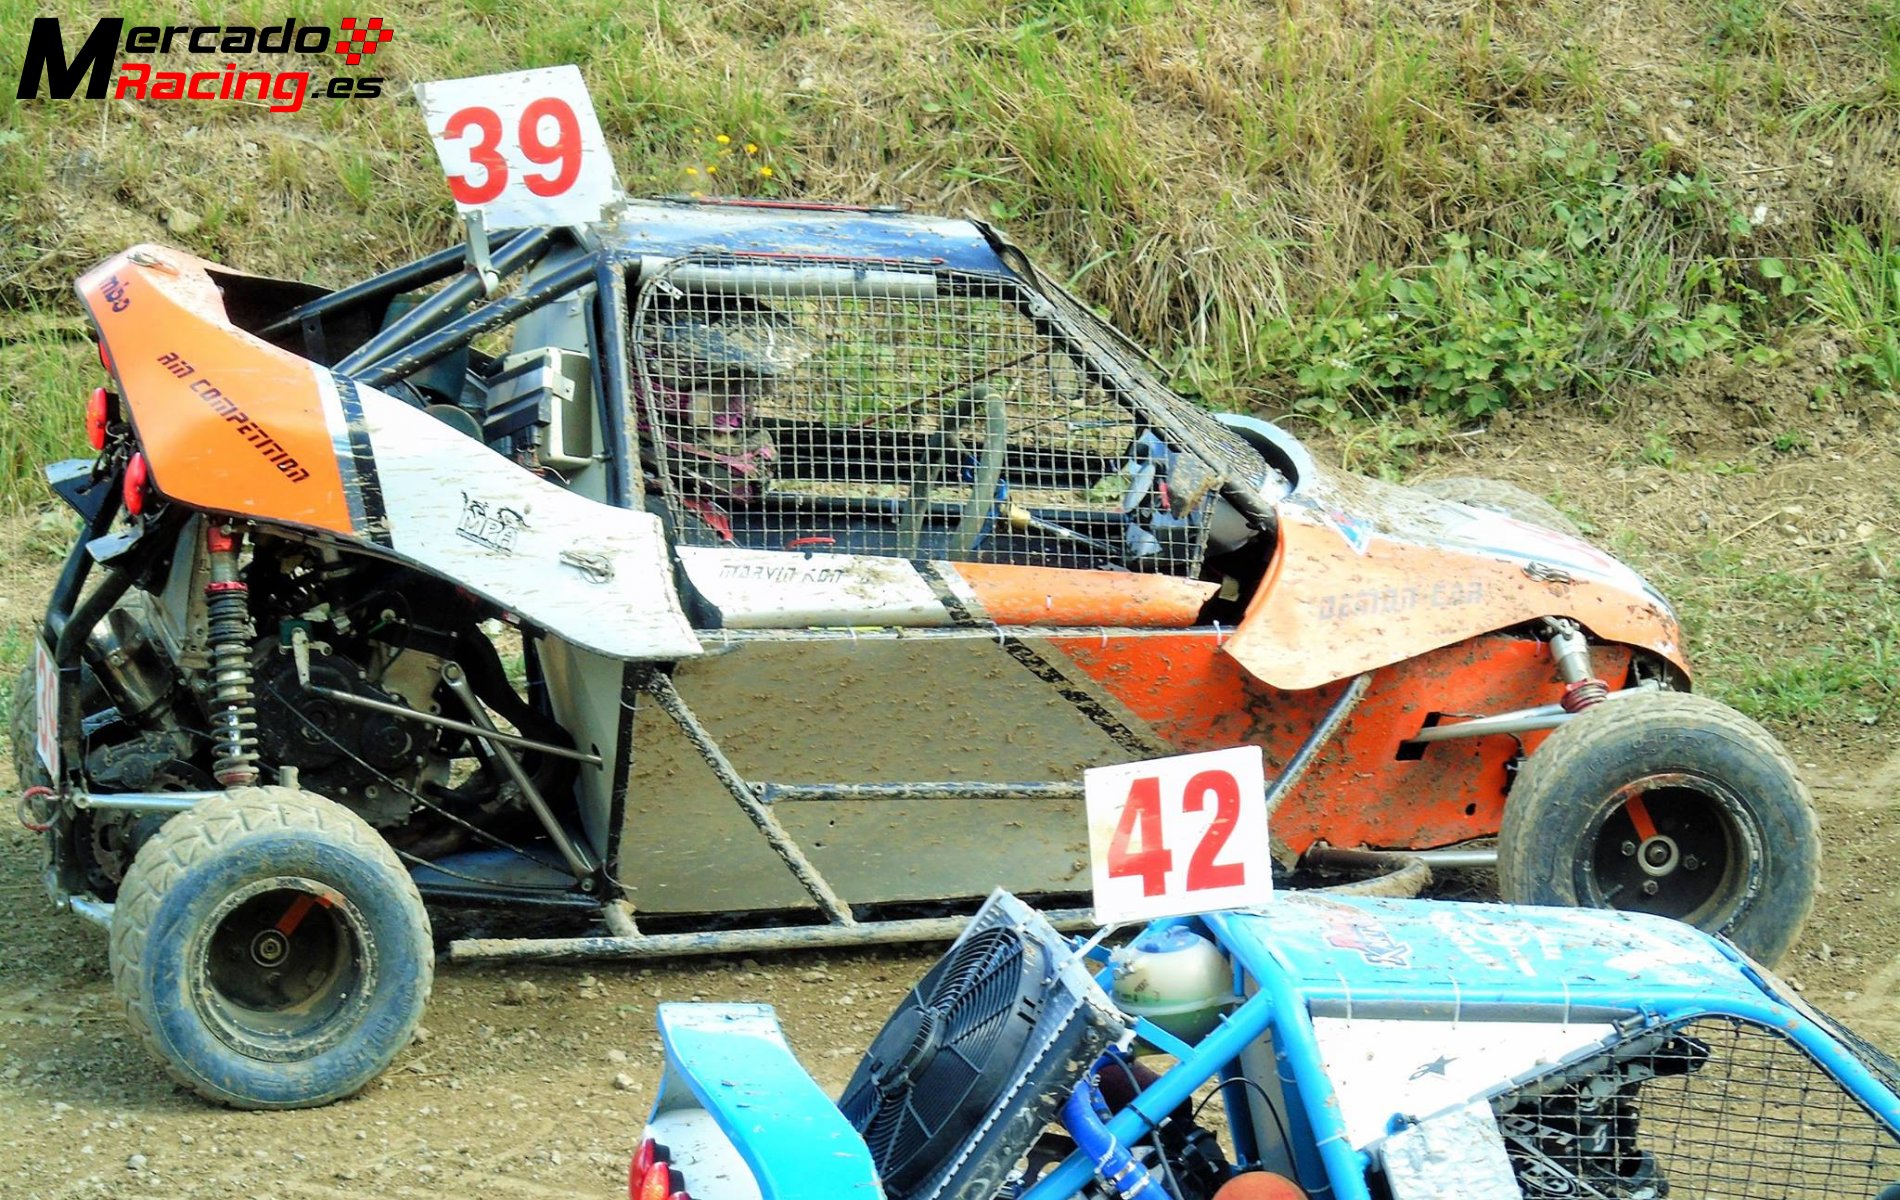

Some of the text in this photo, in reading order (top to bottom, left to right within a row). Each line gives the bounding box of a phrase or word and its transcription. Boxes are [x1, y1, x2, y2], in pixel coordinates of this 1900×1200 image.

[443, 96, 583, 205] 39
[190, 379, 310, 483] COMPETITION
[1107, 769, 1245, 897] 42
